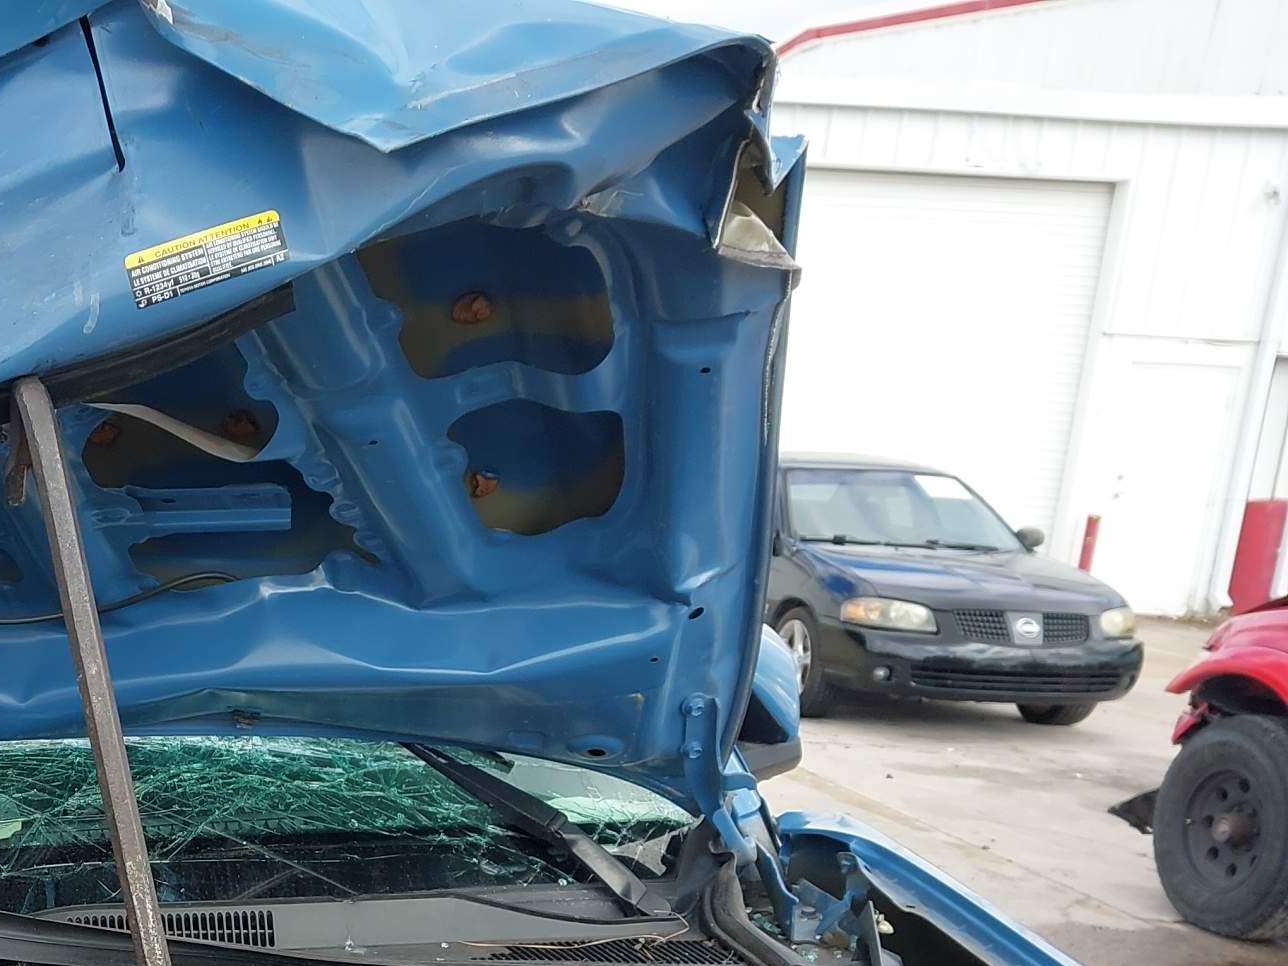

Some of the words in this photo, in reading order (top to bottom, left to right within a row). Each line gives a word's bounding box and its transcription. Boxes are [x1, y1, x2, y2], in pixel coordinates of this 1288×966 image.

[155, 240, 196, 257] CAUTION
[198, 222, 249, 243] ATTENTION
[181, 248, 204, 265] SYSTEM
